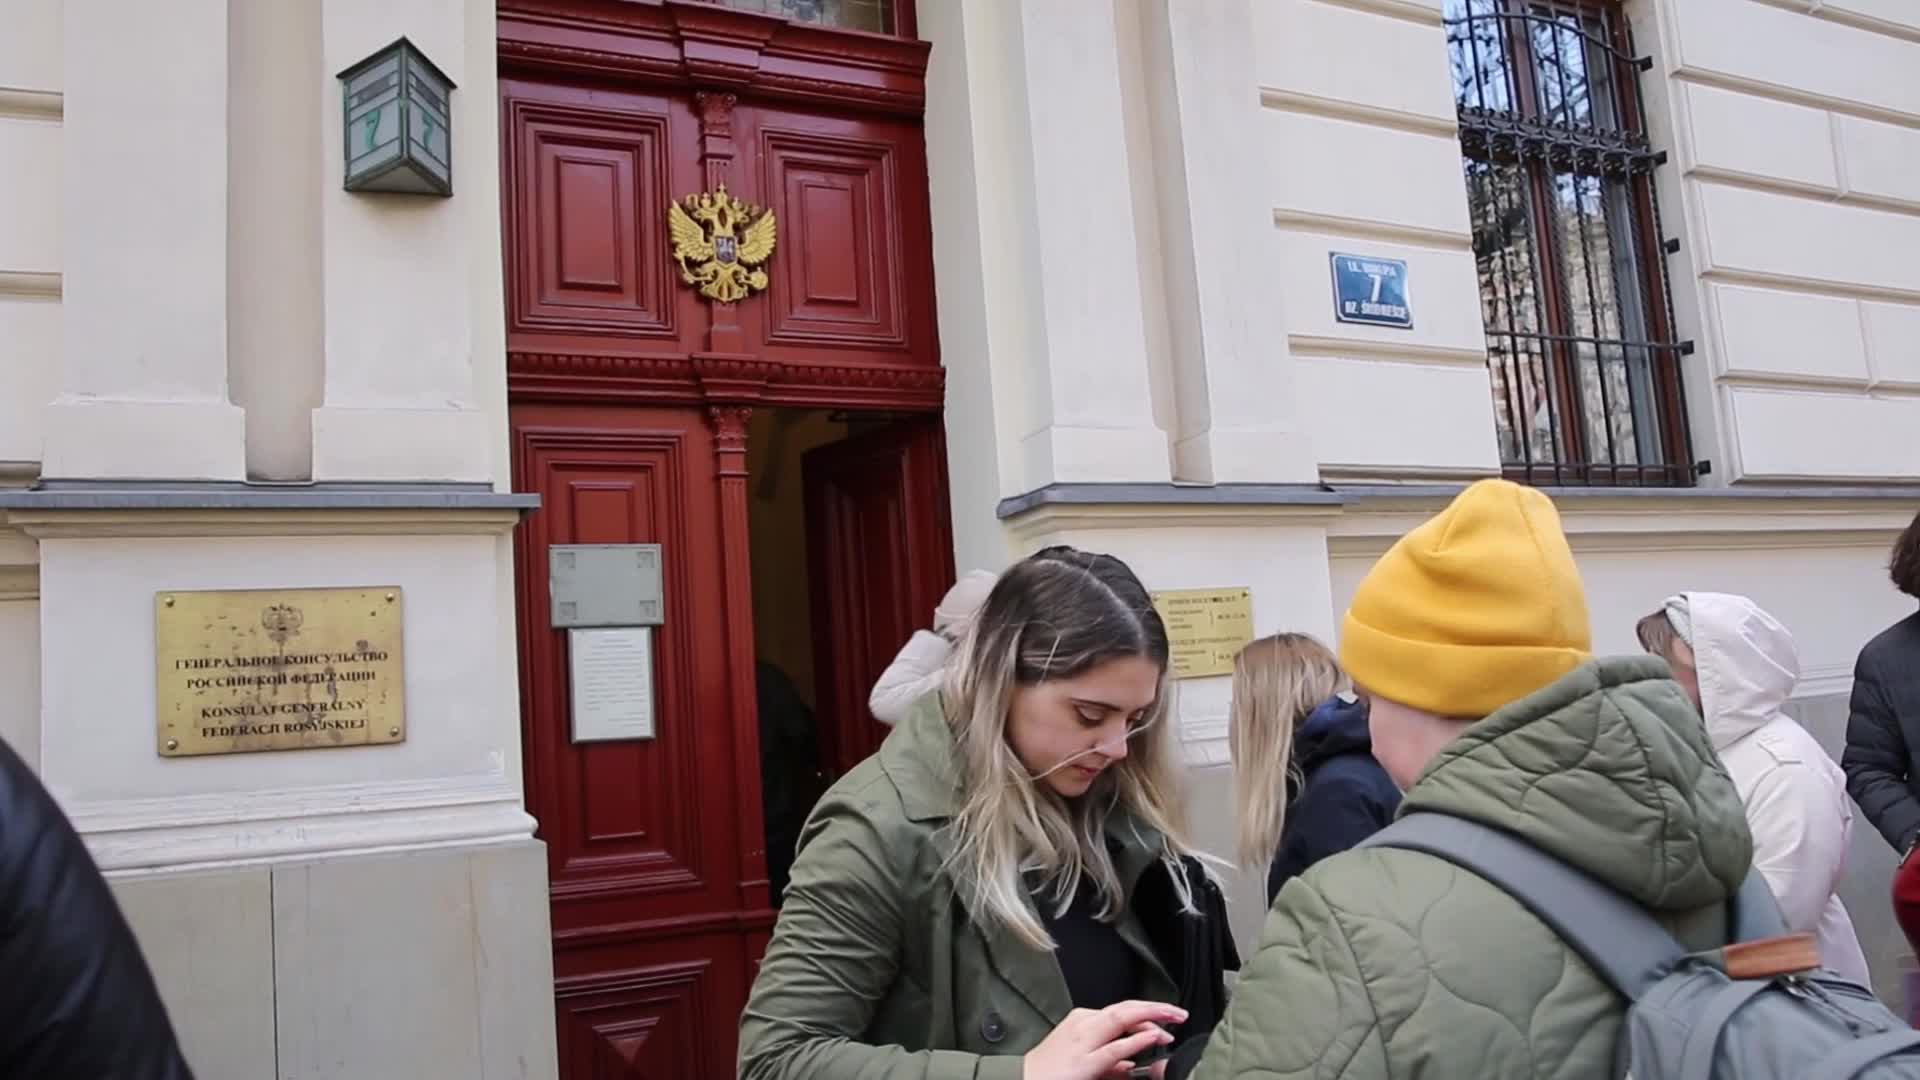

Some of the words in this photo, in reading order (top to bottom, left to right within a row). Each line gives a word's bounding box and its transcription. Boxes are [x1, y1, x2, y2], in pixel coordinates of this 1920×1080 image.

[365, 108, 381, 151] 7
[1368, 273, 1382, 302] 7
[175, 655, 283, 670] ГЕНЕРАЛЬНОЕ
[284, 651, 388, 666] КОНСУЛЬСТВО
[187, 672, 287, 689] РОССИЙСКОЙ
[290, 671, 376, 685] ФЕДЕРАЦИИ
[201, 705, 278, 719] KONSULAT
[280, 700, 366, 714] GENERALNY
[201, 724, 280, 738] FEDERACJI
[284, 719, 366, 733] ROSYJSKIEJ
